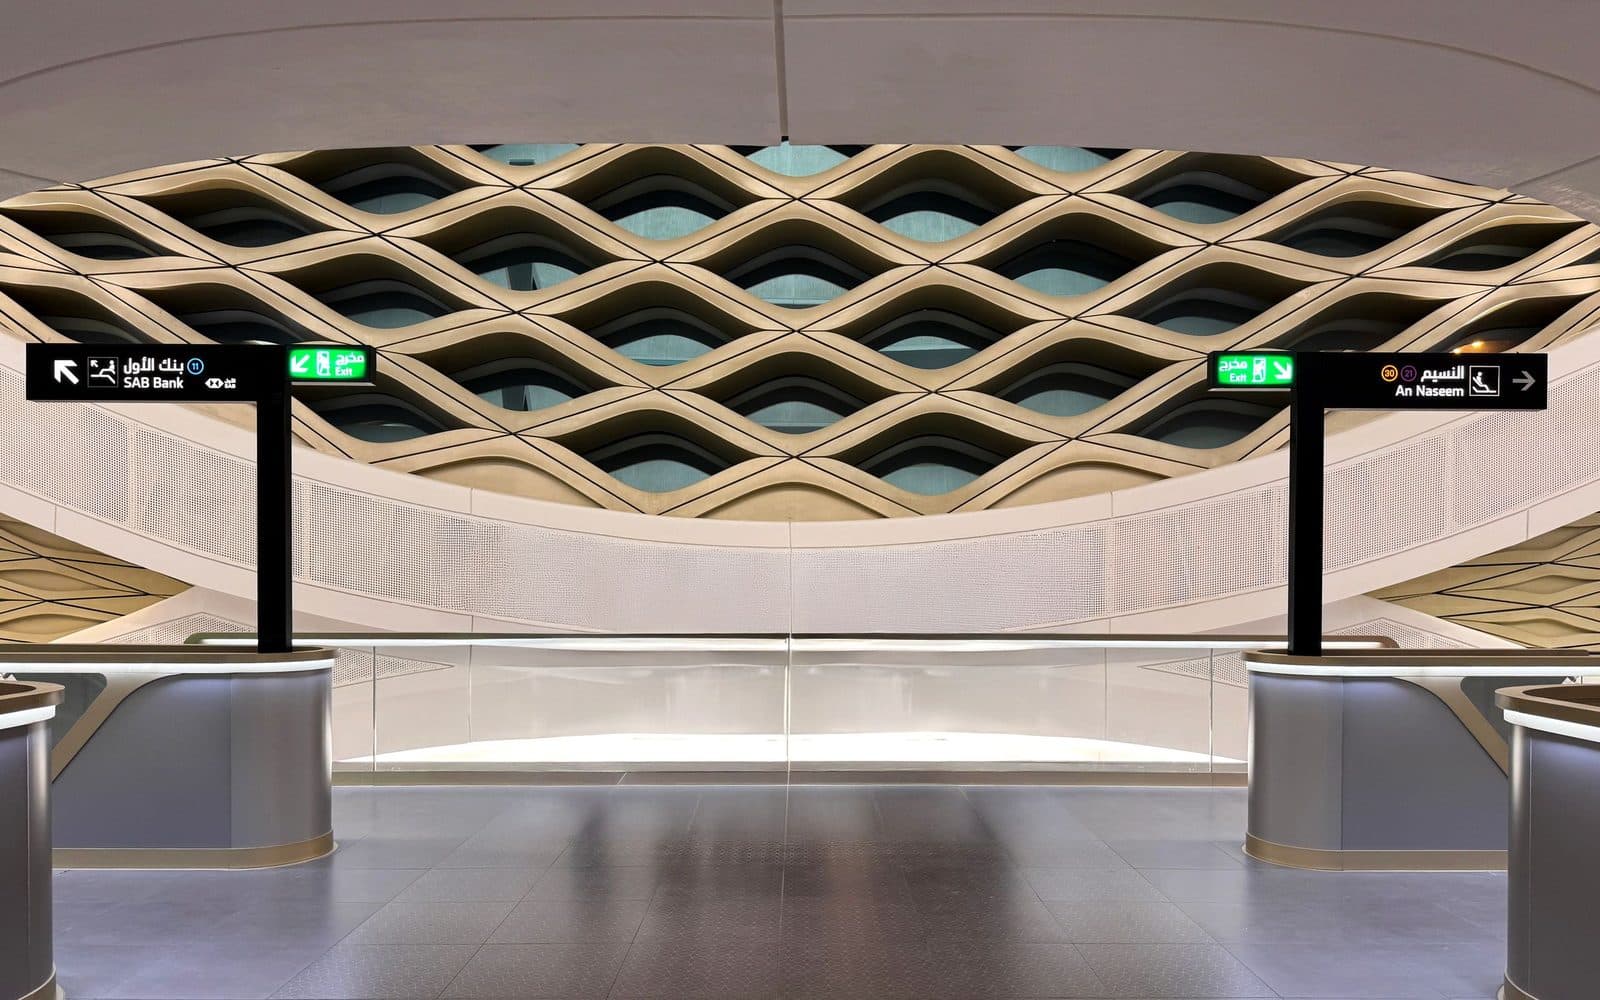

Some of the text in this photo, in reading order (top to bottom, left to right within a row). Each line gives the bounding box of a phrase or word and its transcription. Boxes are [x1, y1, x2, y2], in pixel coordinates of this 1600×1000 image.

[335, 352, 364, 365] مخرج
[1219, 358, 1248, 372] مخرج
[123, 356, 184, 375] بنك الأول
[335, 367, 353, 376] Exit
[1420, 365, 1464, 383] النسيم
[123, 377, 184, 389] SAB Bank
[1395, 385, 1465, 397] An Naseem
